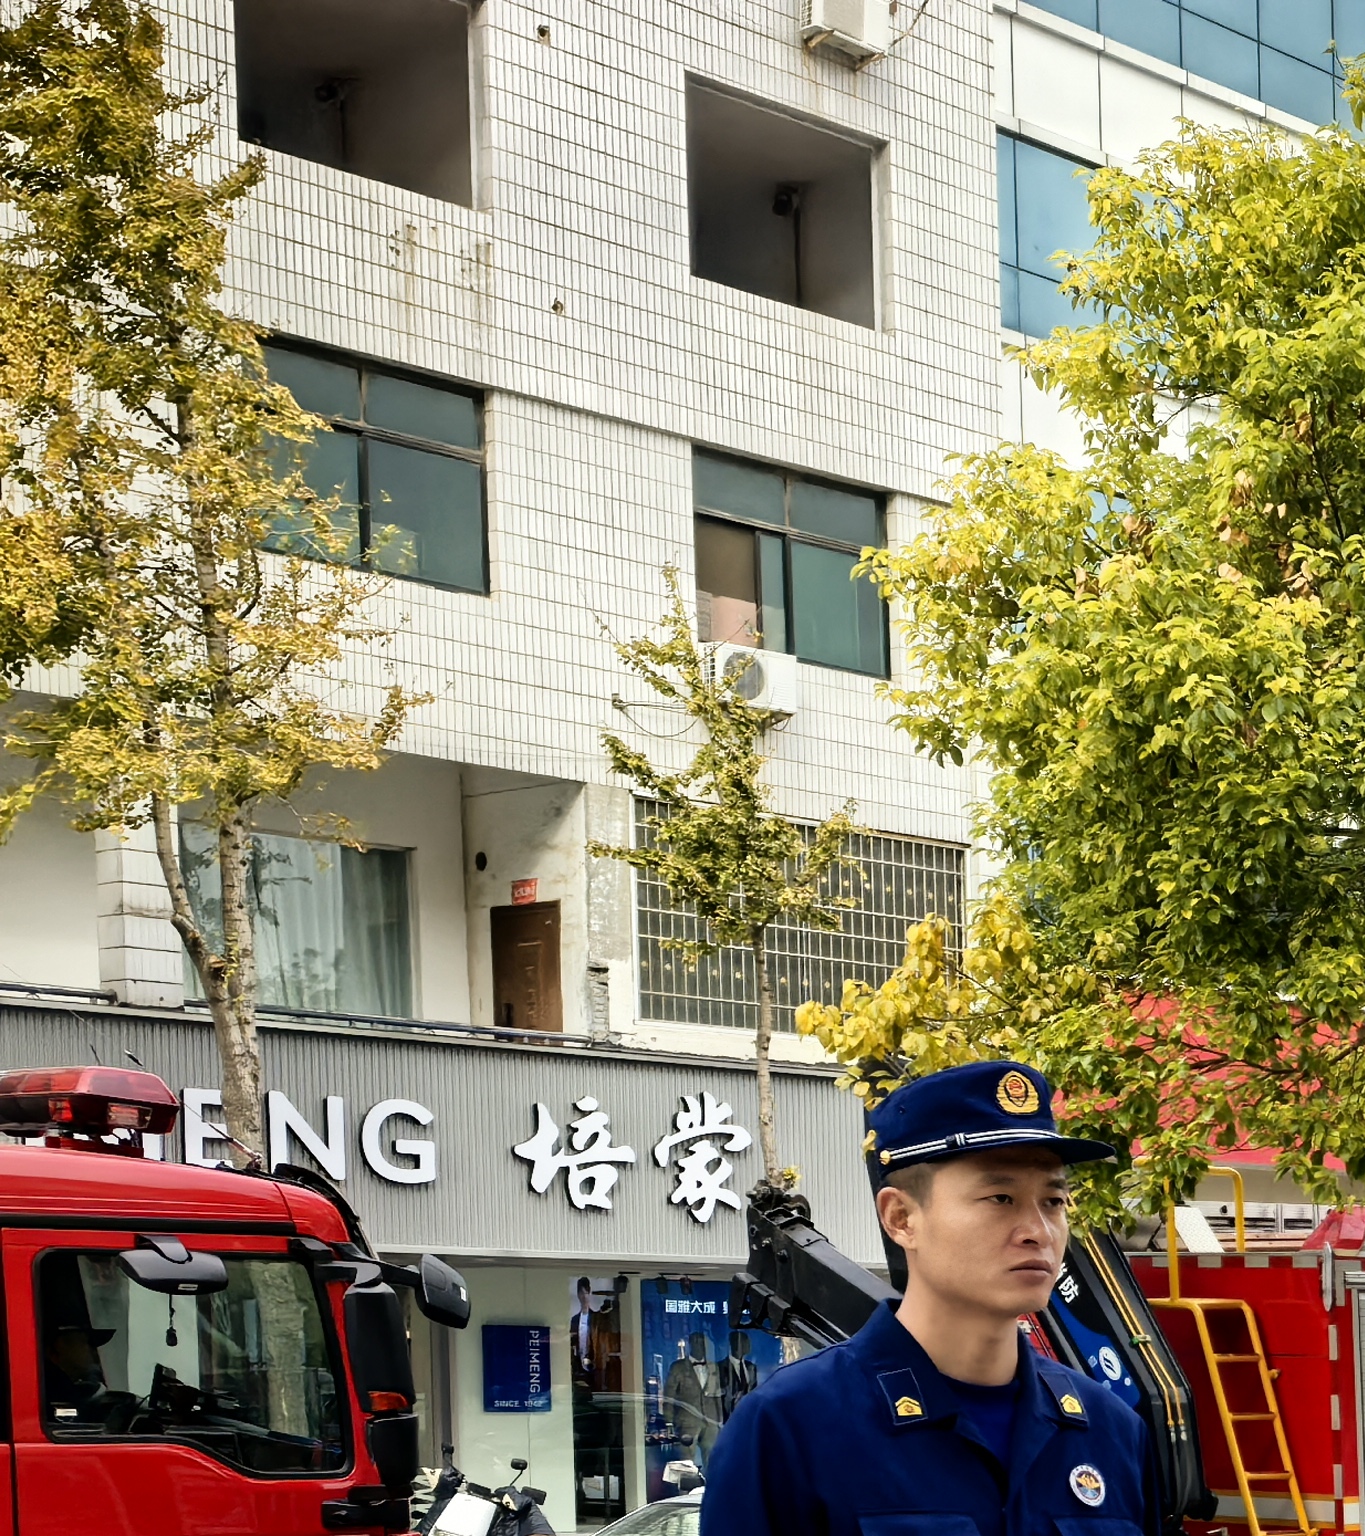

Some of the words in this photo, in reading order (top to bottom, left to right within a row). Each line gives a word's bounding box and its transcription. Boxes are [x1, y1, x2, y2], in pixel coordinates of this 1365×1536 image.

[72, 1087, 437, 1184] ENG
[513, 1090, 752, 1224] 培蒙
[529, 1330, 541, 1393] PEIMENG
